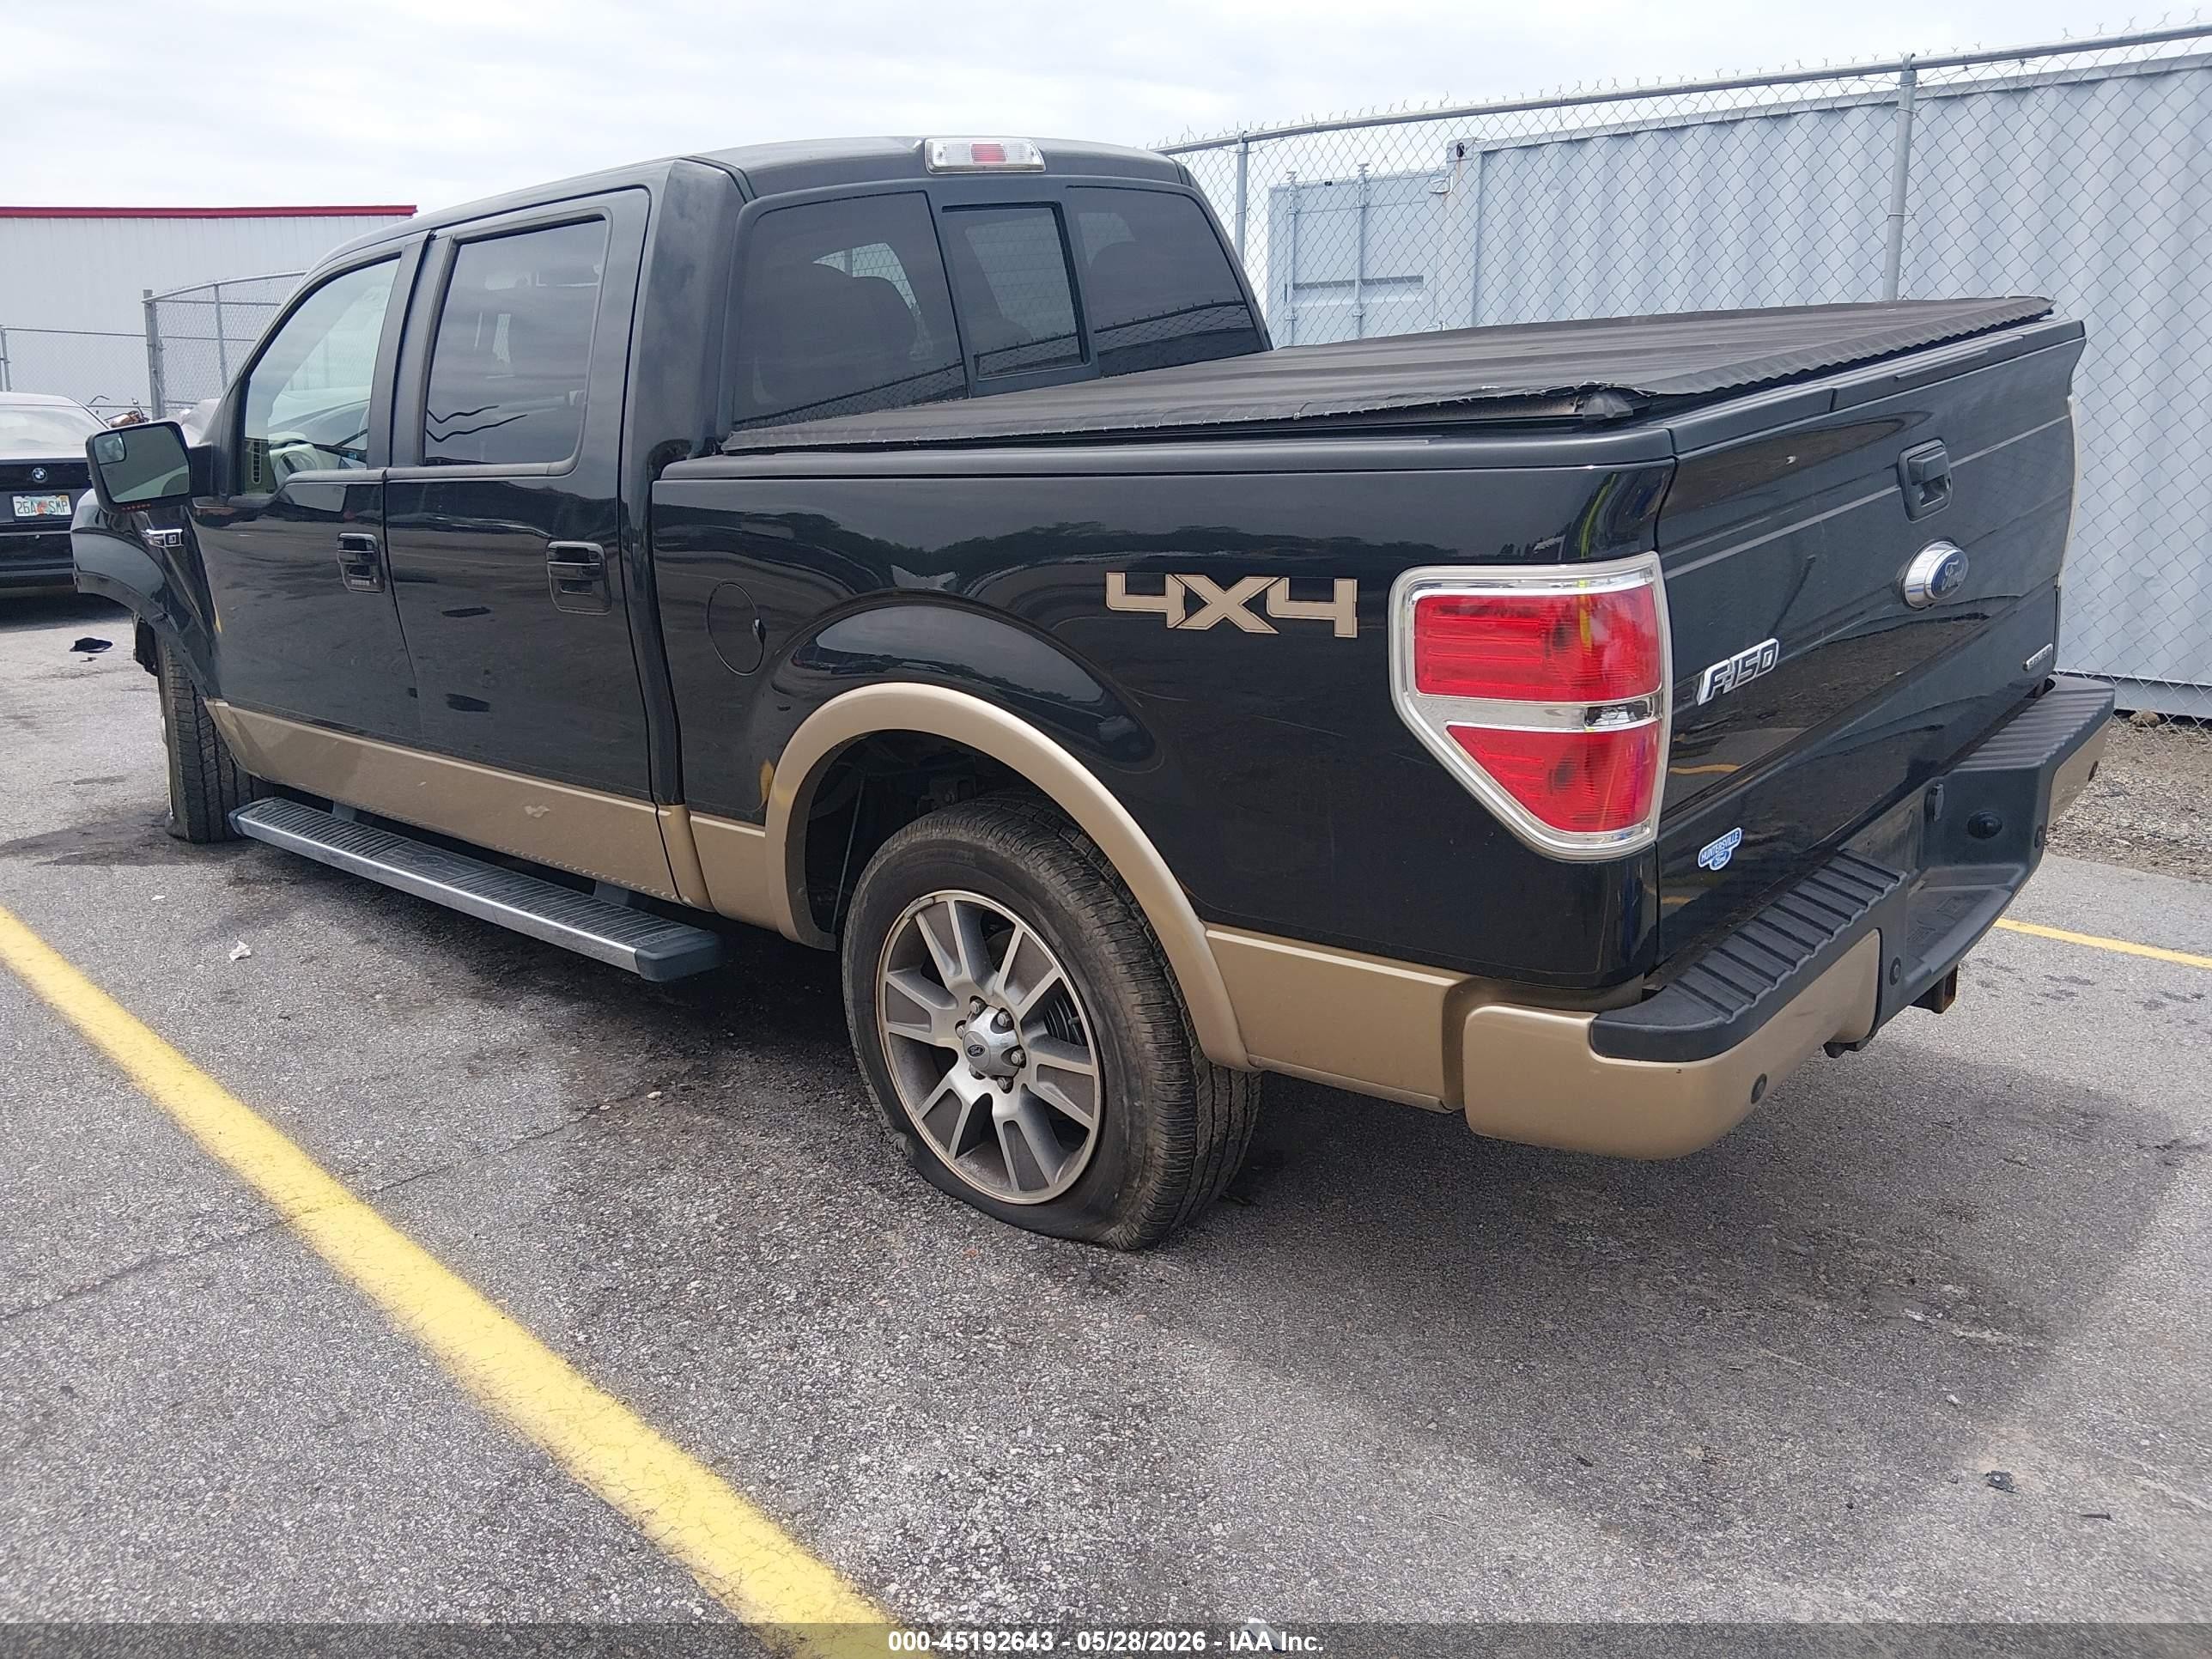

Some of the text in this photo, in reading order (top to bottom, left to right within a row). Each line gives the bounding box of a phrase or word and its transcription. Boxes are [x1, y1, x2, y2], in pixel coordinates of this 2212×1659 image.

[15, 501, 68, 514] 26A SMP
[1941, 558, 1965, 592] Ford
[1697, 638, 1779, 706] F-150
[1700, 831, 1739, 863] HUNTERSVILLE
